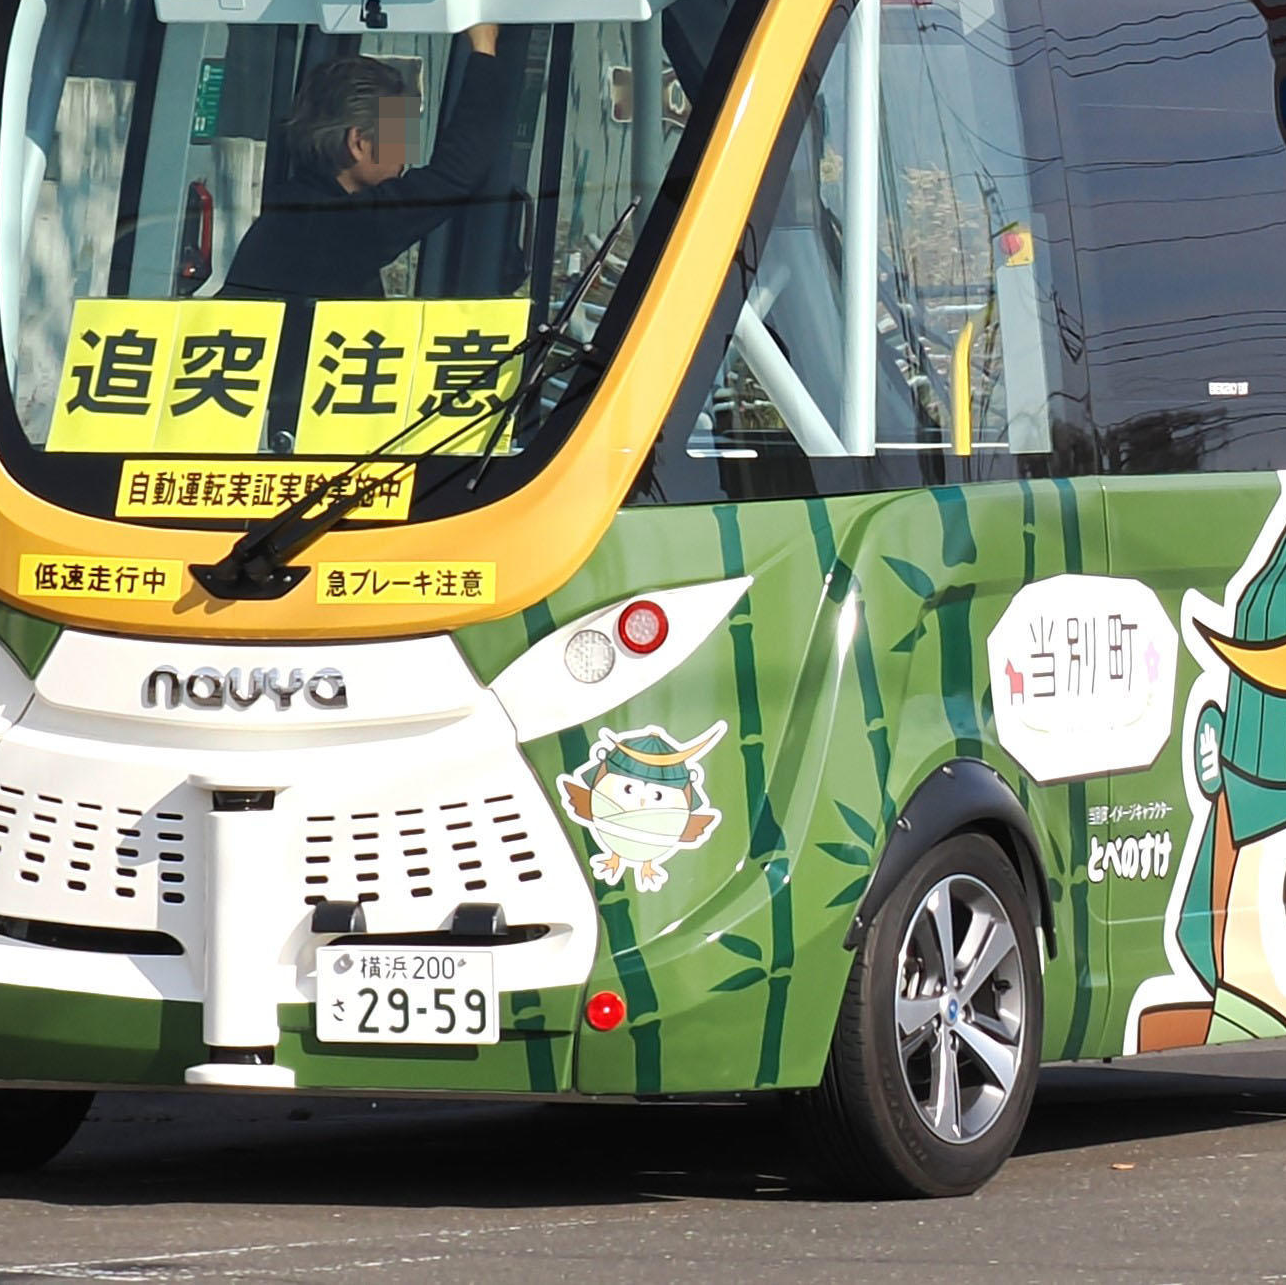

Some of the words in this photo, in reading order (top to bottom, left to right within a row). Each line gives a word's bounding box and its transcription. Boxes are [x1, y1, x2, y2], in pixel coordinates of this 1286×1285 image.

[66, 328, 267, 418] 追突
[311, 328, 516, 418] 注意
[34, 562, 166, 595] 低速走行中
[325, 569, 484, 598] 急ブレーキ注意
[1029, 614, 1138, 698] 当別町
[141, 665, 349, 712] navya
[1087, 829, 1172, 884] とべのすけ
[331, 998, 346, 1022] さ
[357, 987, 487, 1035] 29-59
